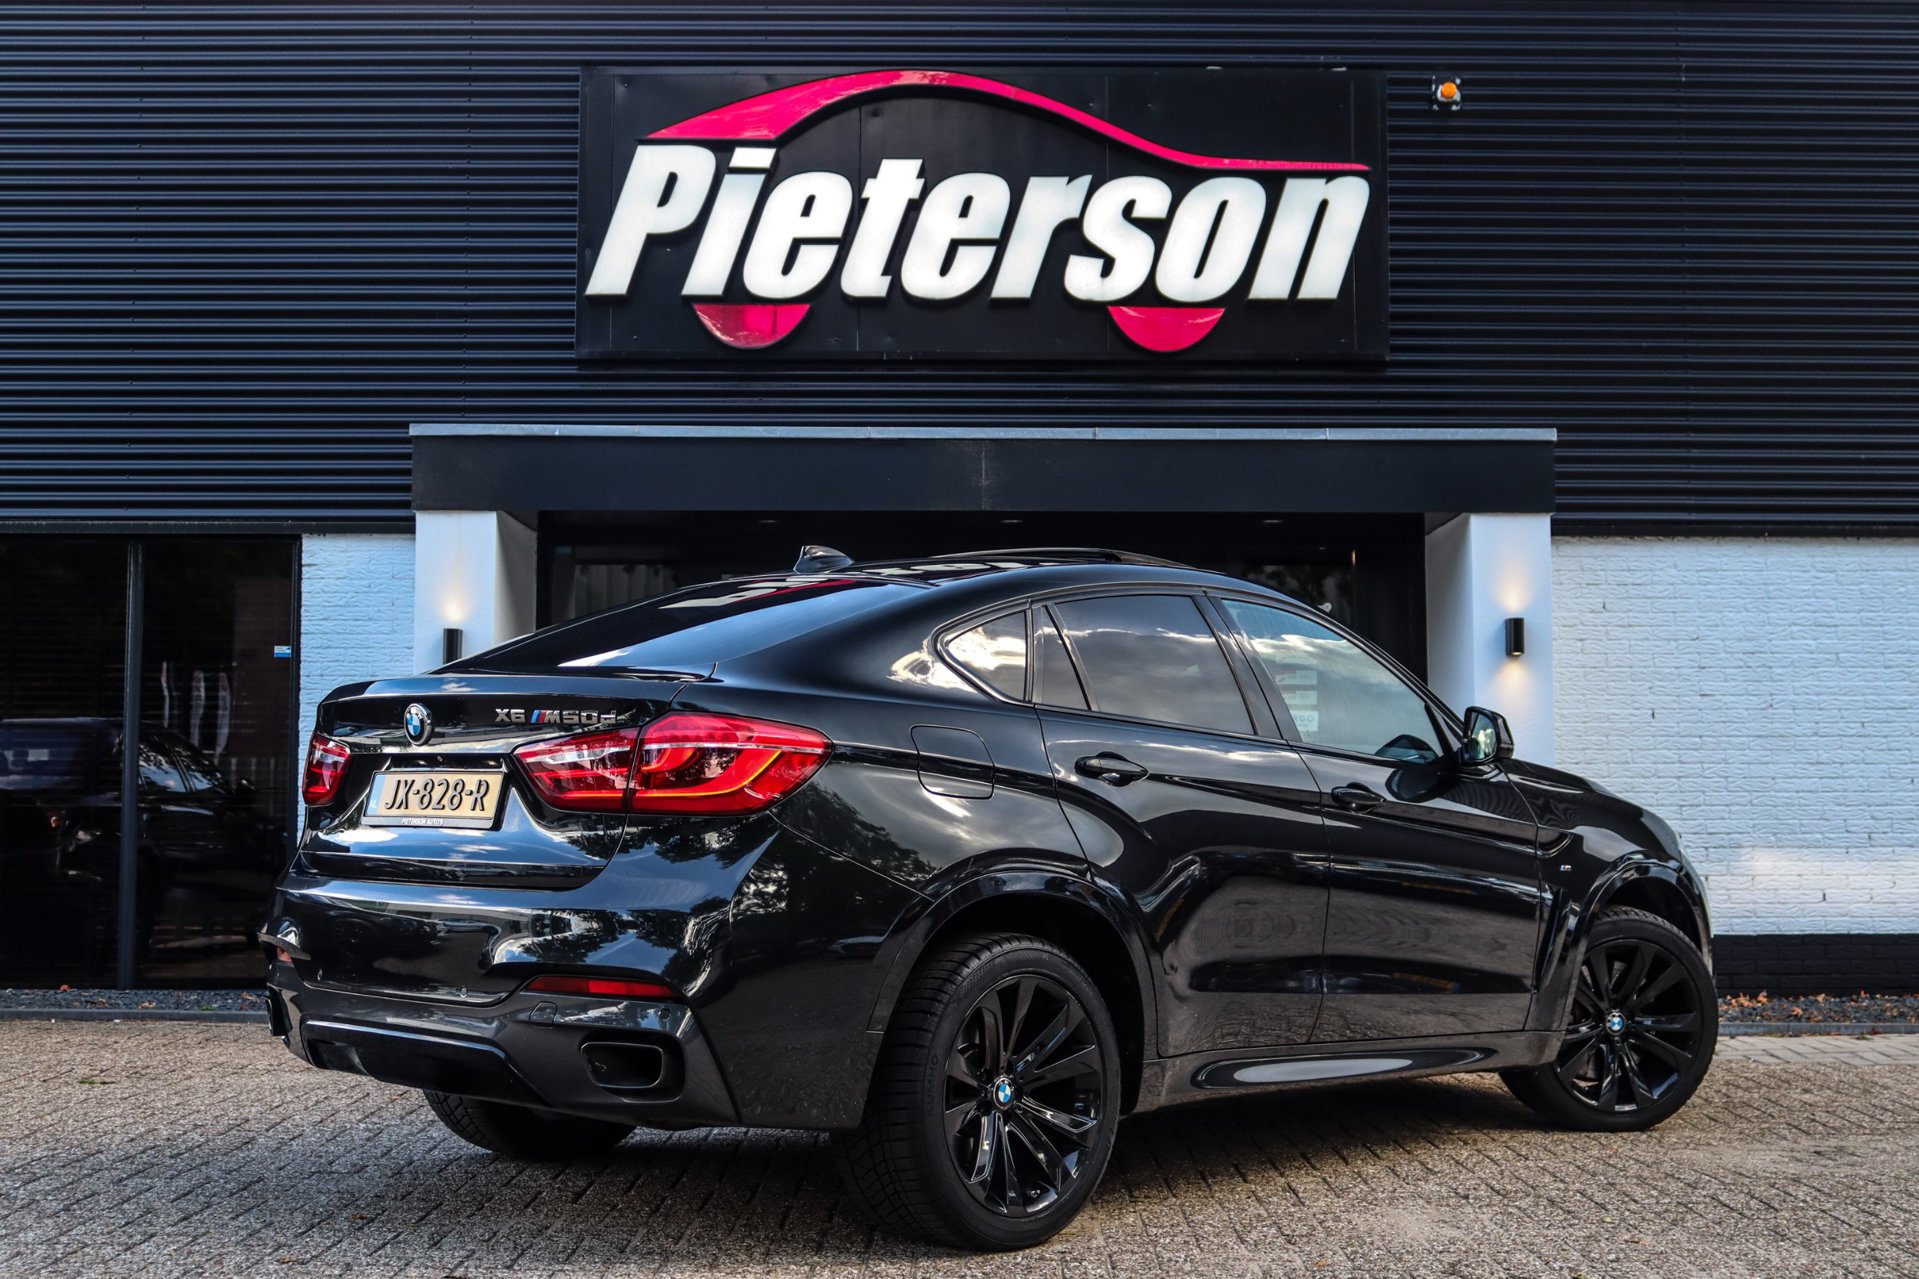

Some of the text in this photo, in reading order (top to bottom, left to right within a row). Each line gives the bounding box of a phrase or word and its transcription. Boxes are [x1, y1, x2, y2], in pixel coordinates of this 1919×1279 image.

[584, 144, 1370, 303] Pieterson
[494, 708, 526, 724] X6
[384, 778, 490, 811] JX-828-R
